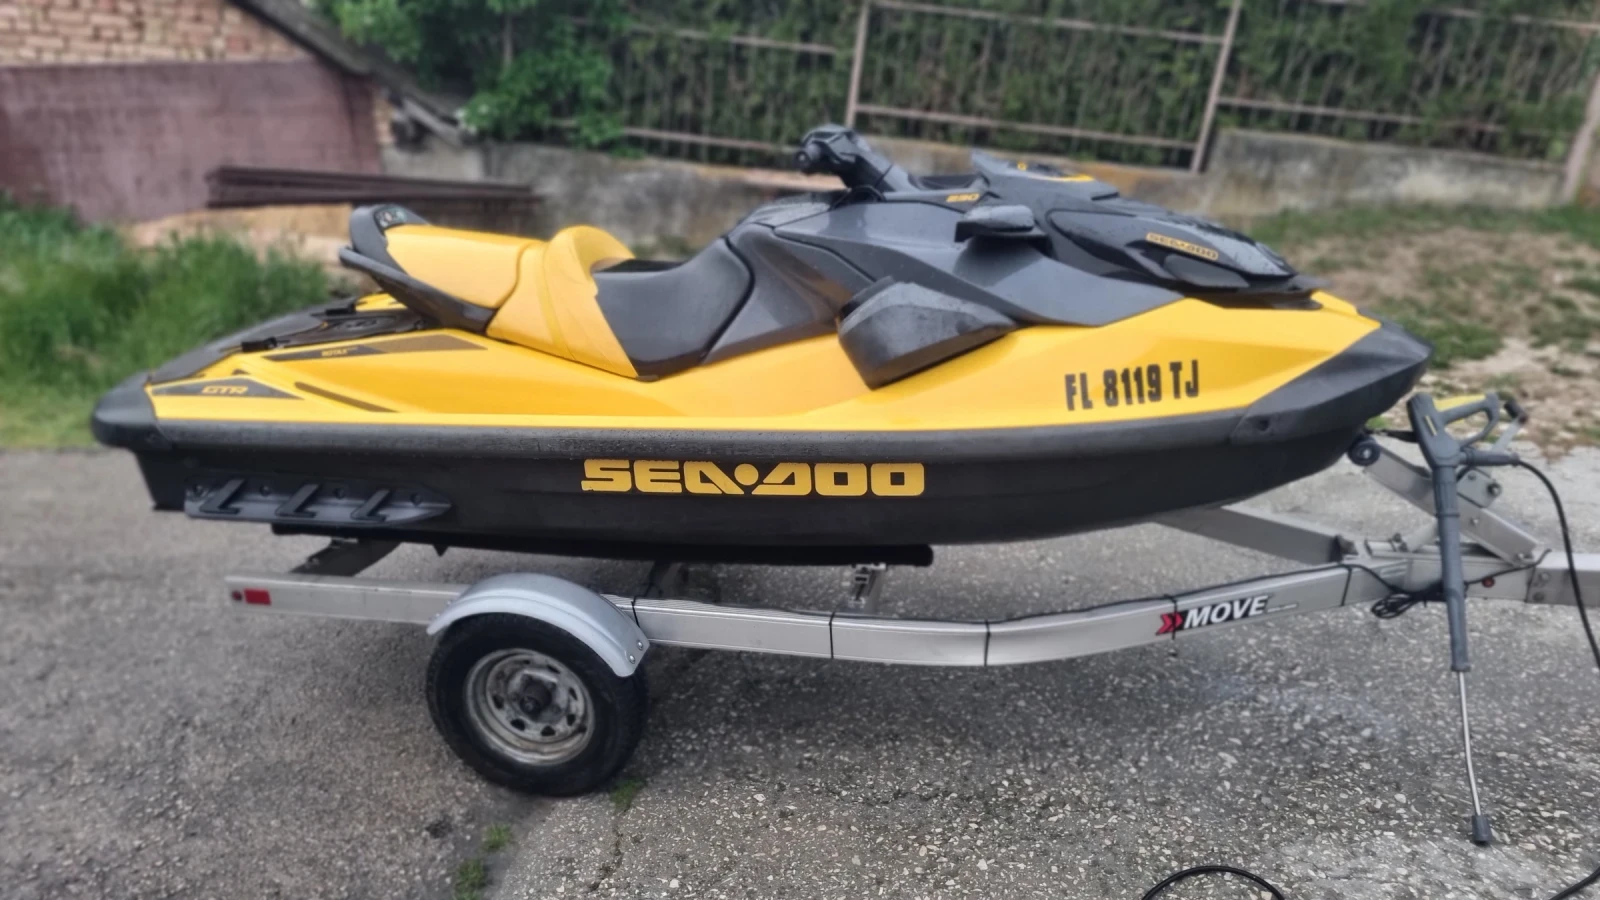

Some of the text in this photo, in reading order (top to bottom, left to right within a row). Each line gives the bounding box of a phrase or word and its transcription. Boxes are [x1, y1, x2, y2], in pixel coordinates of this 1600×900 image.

[202, 385, 249, 394] GTR
[1064, 359, 1199, 411] FL 8119 TJ
[1183, 595, 1269, 629] MOVE
